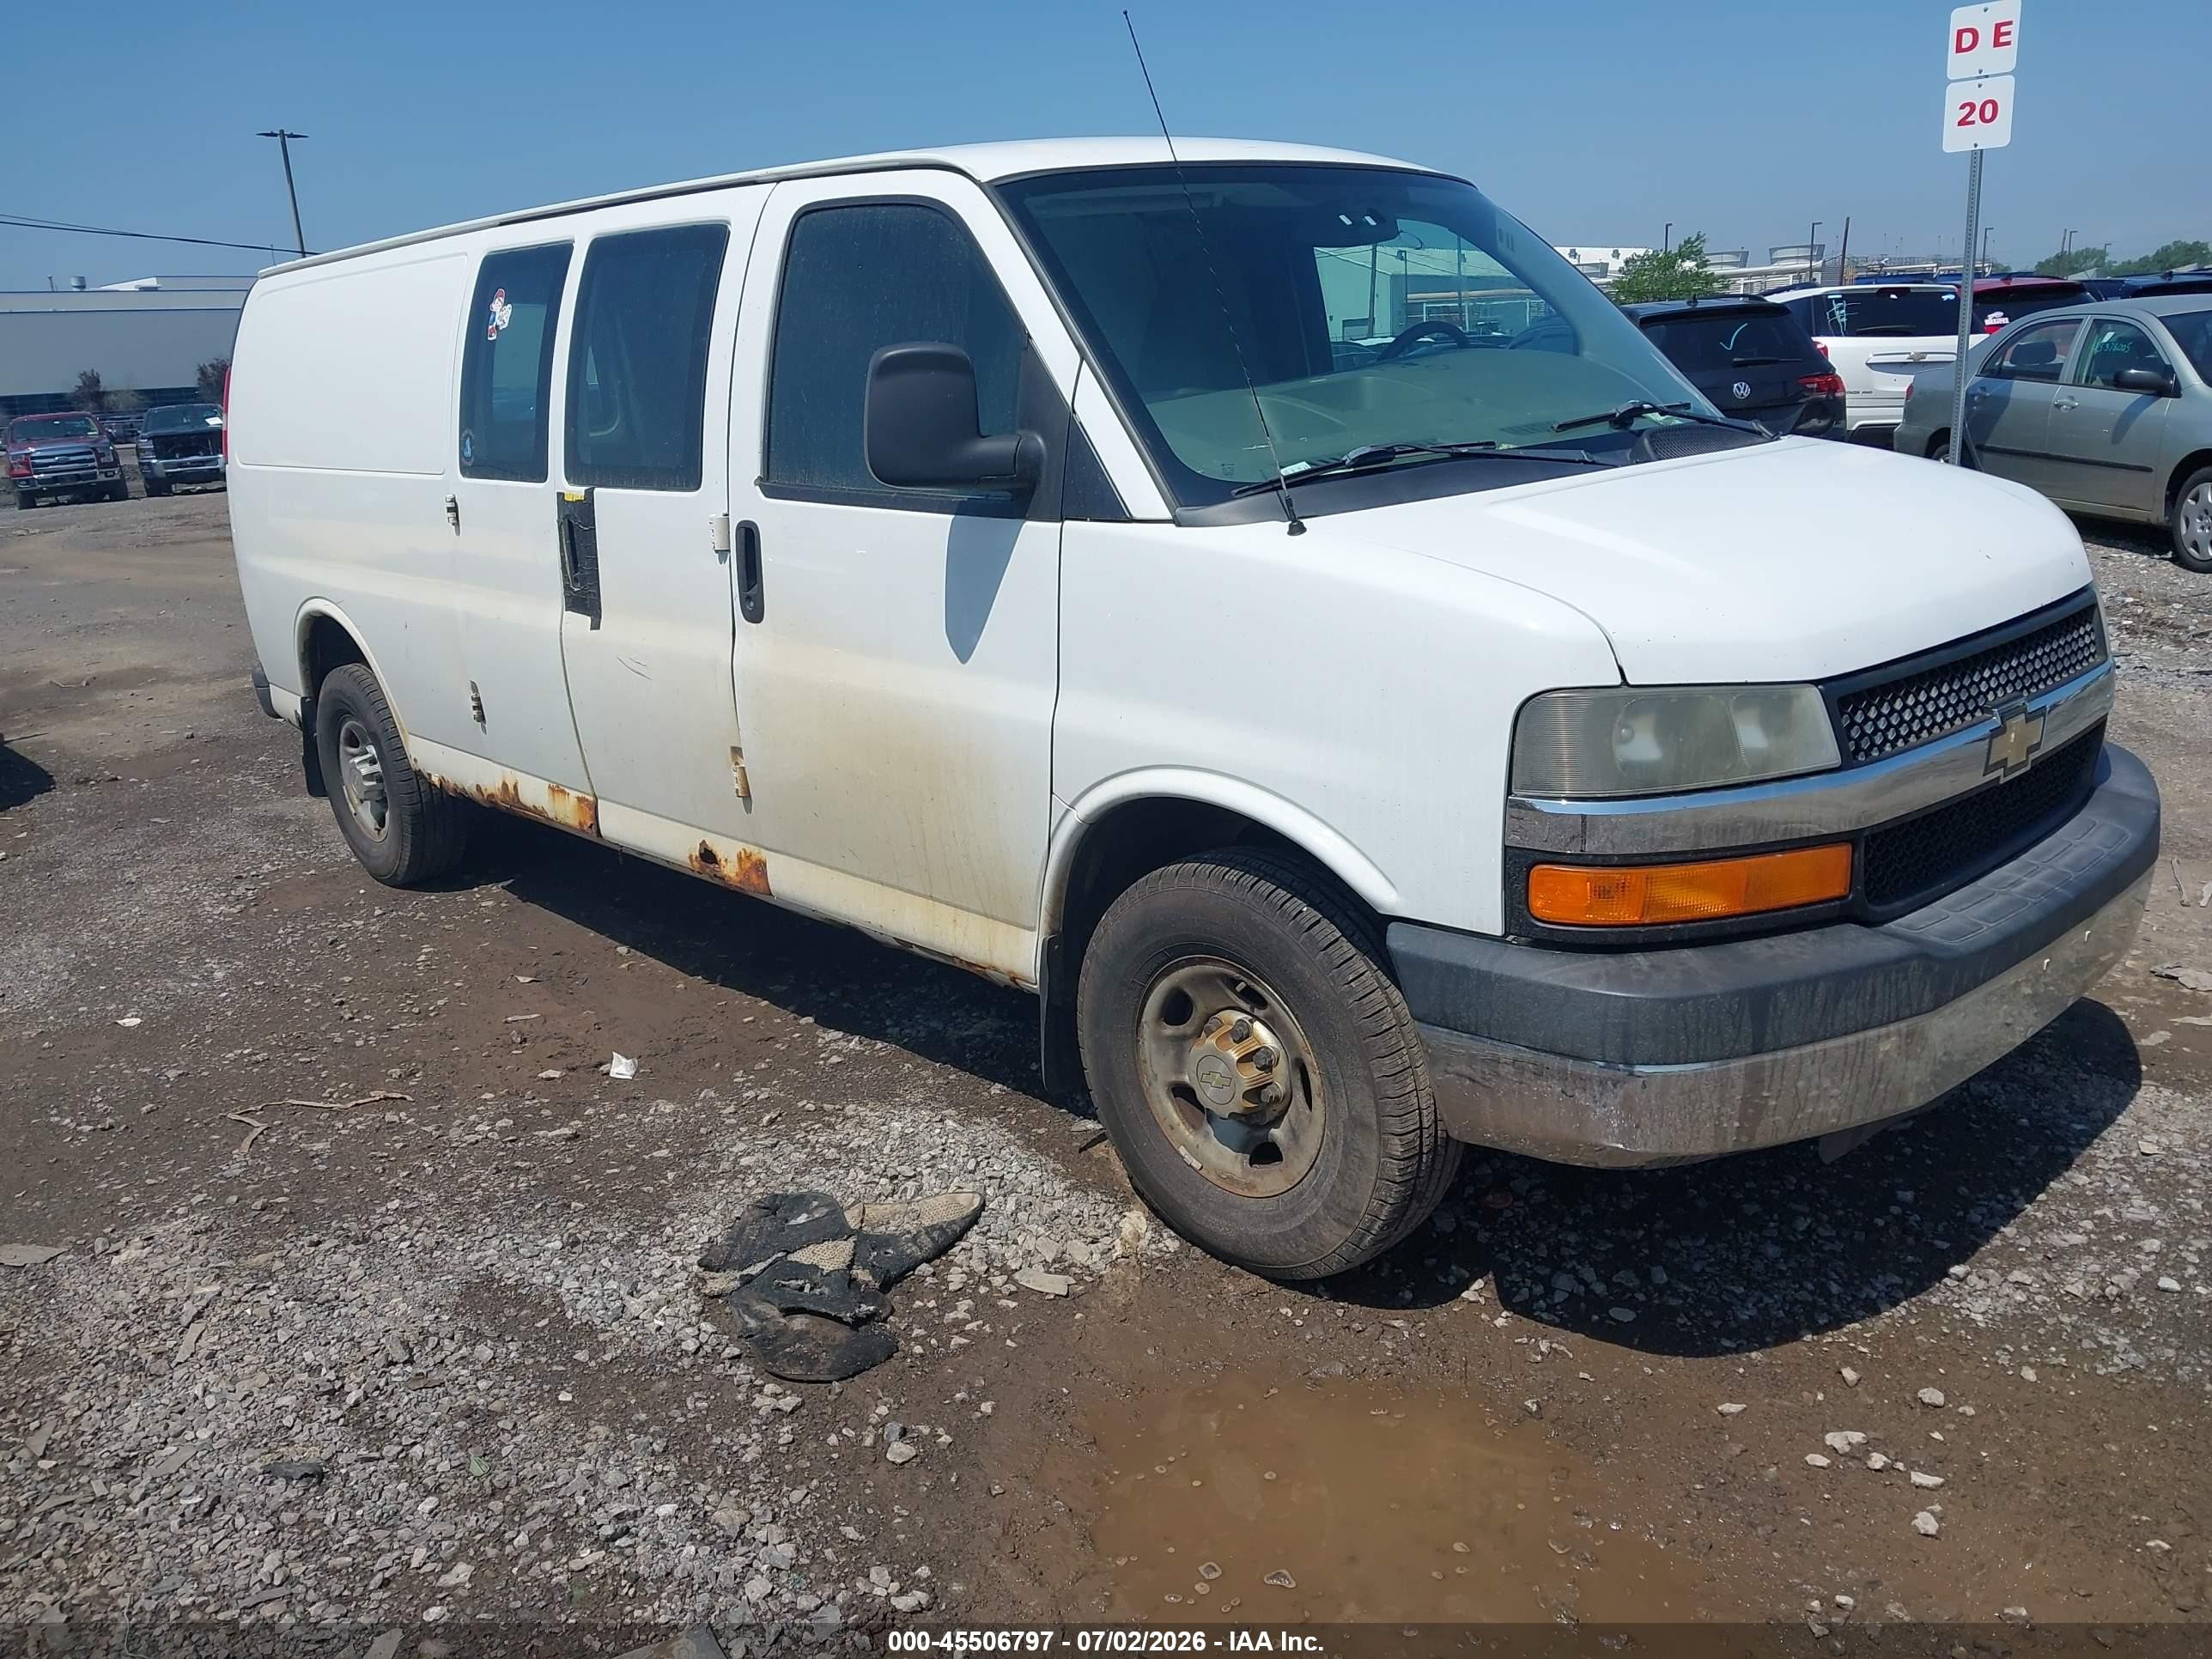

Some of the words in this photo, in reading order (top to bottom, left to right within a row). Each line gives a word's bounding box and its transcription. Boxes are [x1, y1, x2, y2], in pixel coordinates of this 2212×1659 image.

[1955, 27, 1979, 53] D
[1993, 21, 2014, 48] E
[1957, 99, 1999, 127] 20
